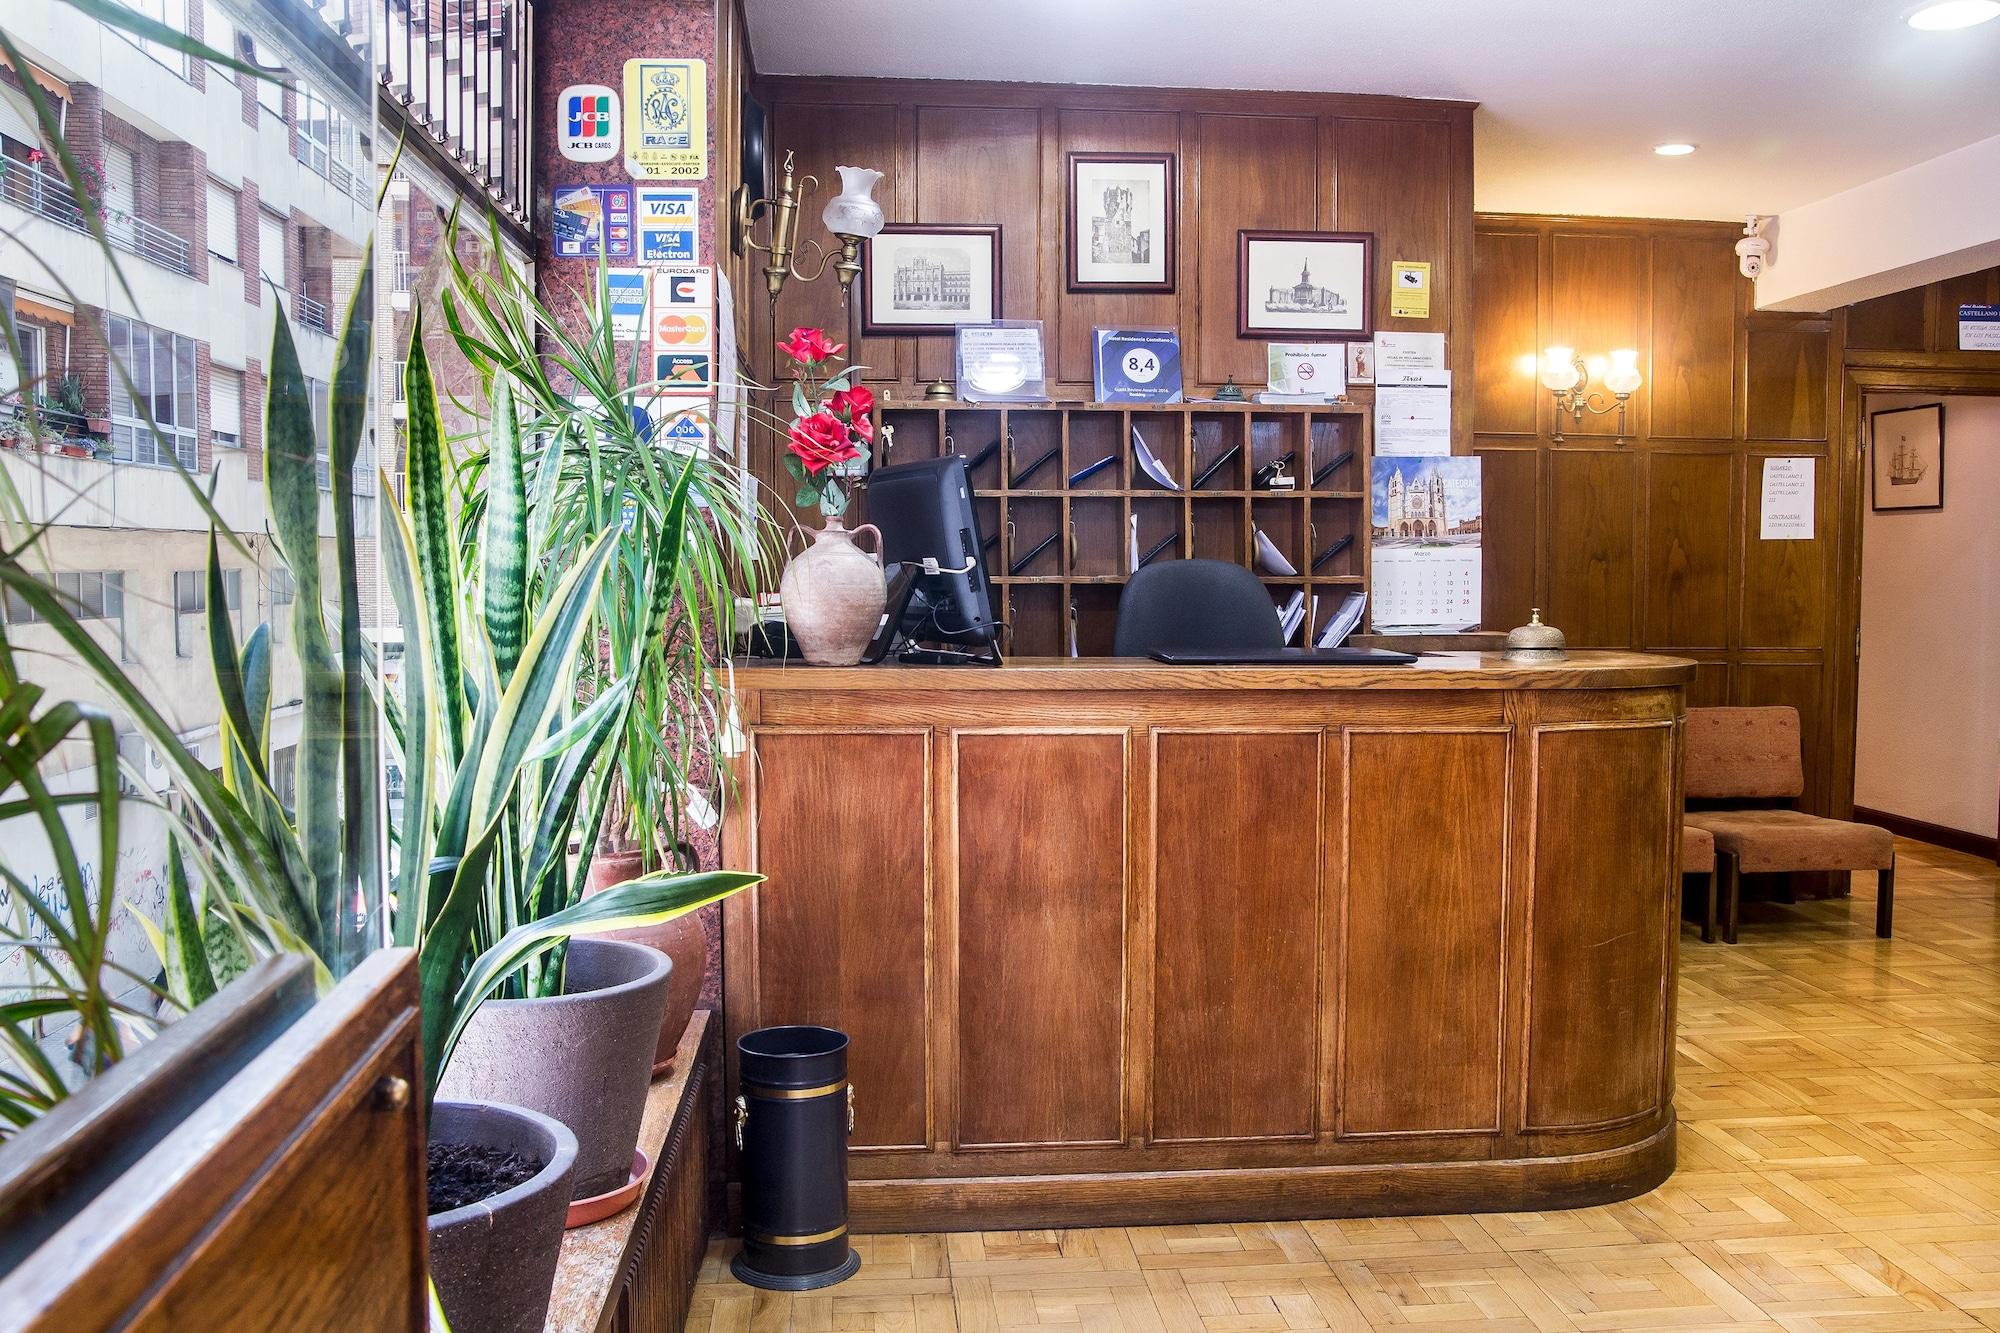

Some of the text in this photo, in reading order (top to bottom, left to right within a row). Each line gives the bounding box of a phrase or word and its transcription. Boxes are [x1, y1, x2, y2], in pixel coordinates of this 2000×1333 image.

[568, 112, 609, 121] JCB
[645, 136, 688, 145] RACE
[646, 167, 660, 175] 01
[671, 167, 700, 175] 2002
[650, 203, 686, 215] VISA
[654, 233, 681, 243] VISA
[646, 249, 690, 259] Electron
[659, 325, 706, 333] MasterCard
[1129, 357, 1155, 372] 8,4
